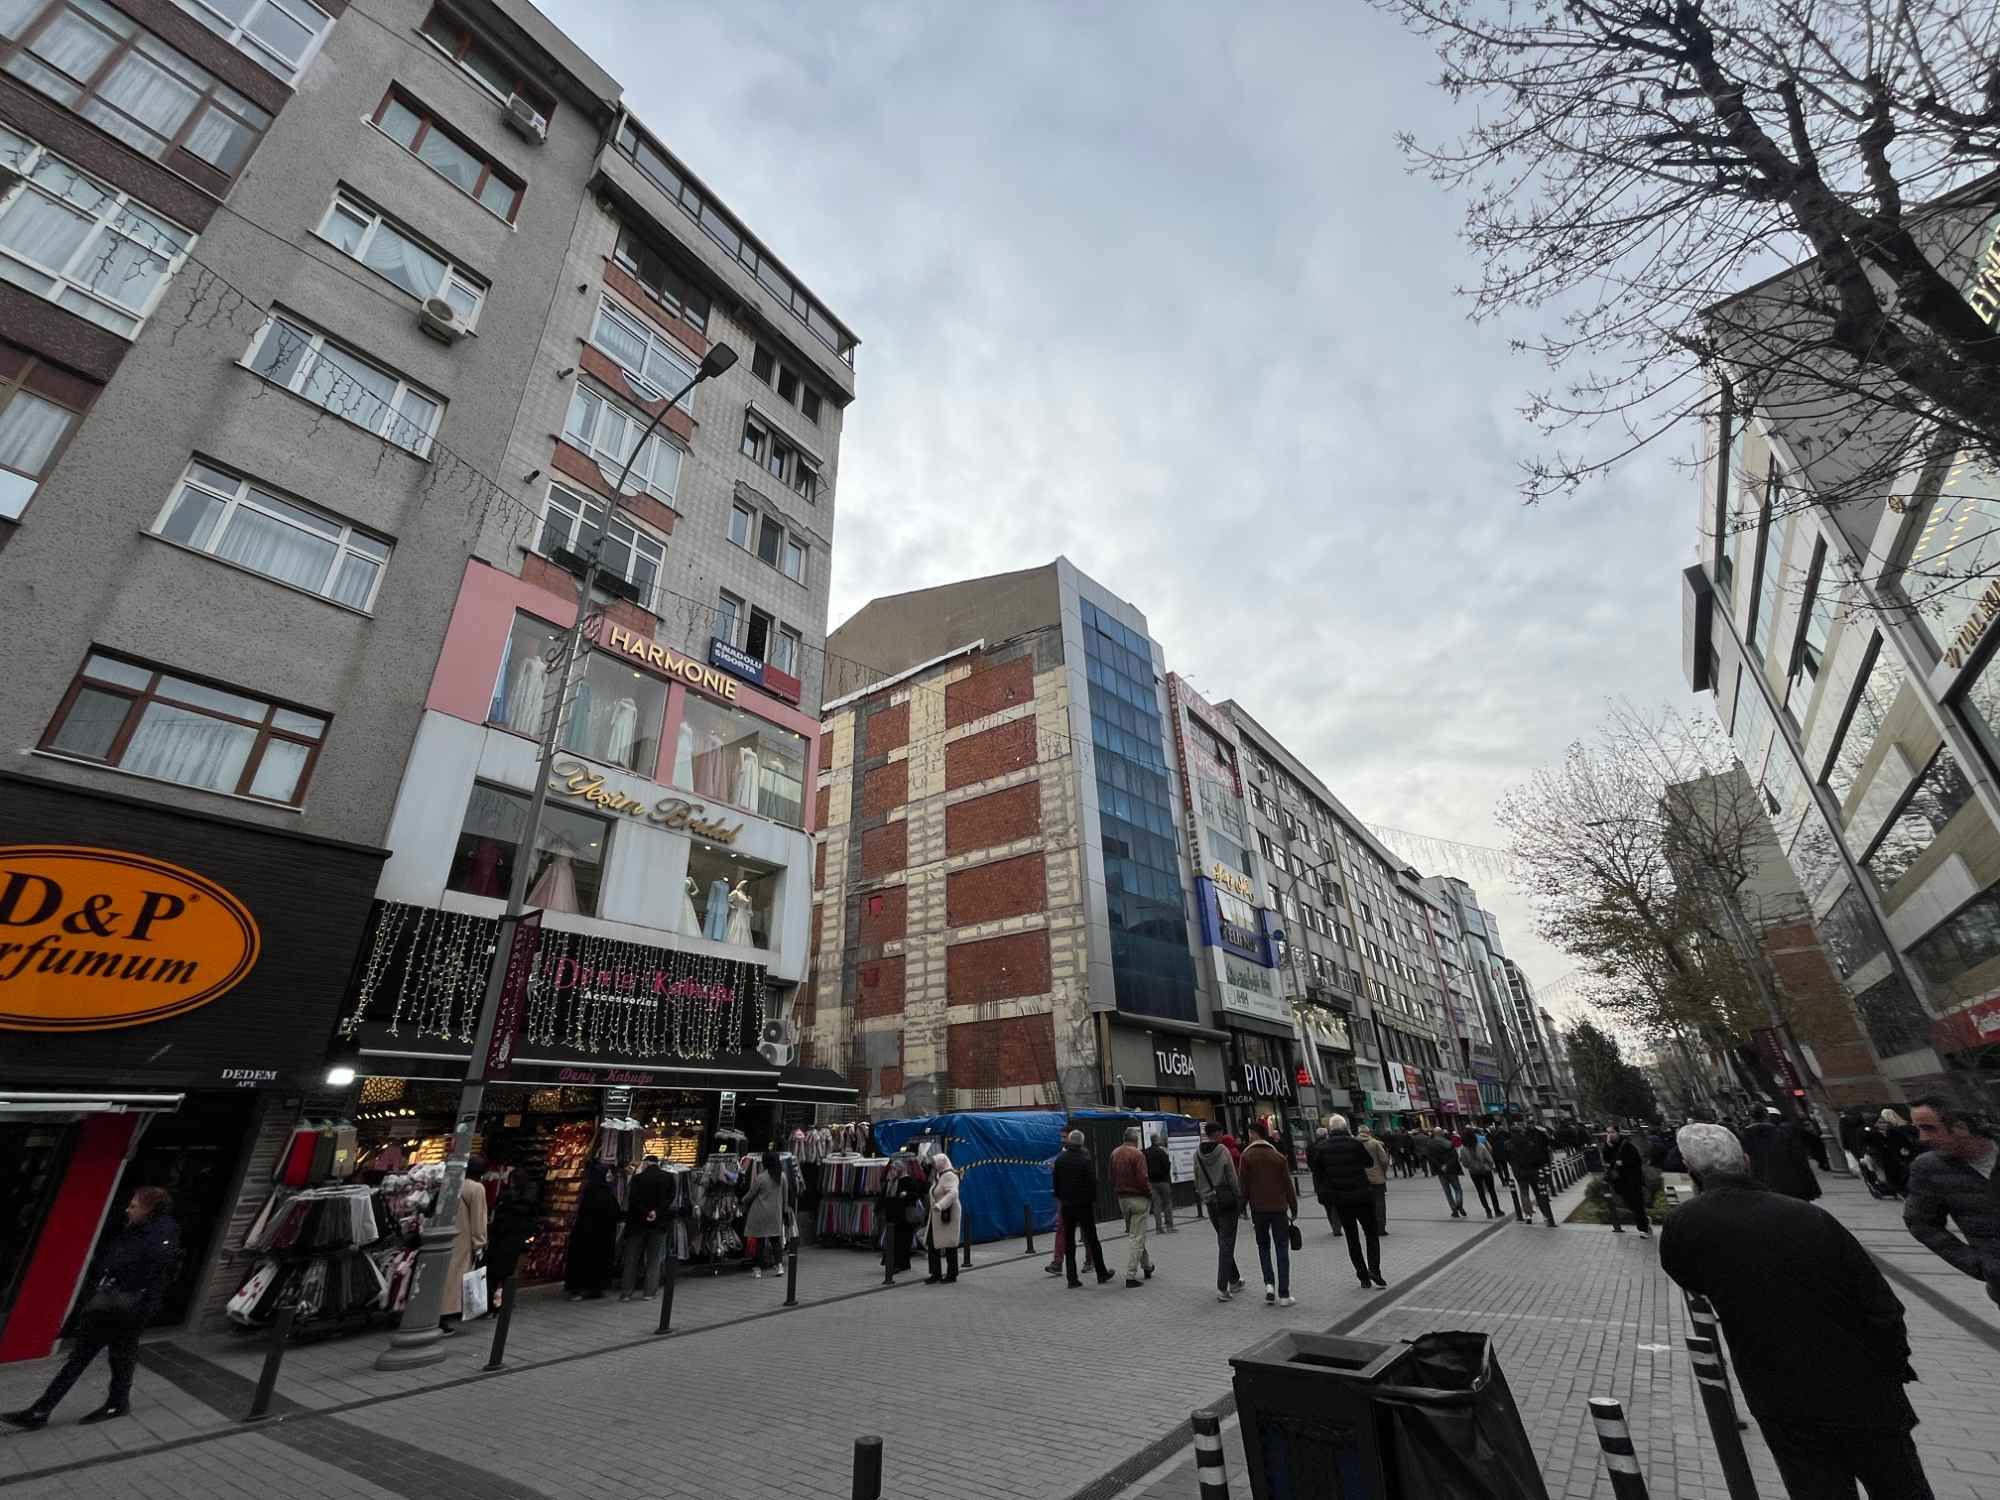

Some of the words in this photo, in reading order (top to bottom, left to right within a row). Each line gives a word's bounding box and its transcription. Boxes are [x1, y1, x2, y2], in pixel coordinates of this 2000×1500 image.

[609, 623, 737, 700] HARMONIE
[714, 641, 762, 670] ANADOLU
[549, 759, 646, 816] Yeşim
[649, 797, 744, 845] Bridal
[0, 935, 199, 984] rfumum
[584, 992, 658, 1007] Accessories
[220, 1068, 278, 1080] DEDEM
[1156, 1048, 1197, 1076] TUĞBA
[1244, 1063, 1292, 1097] PUDRA
